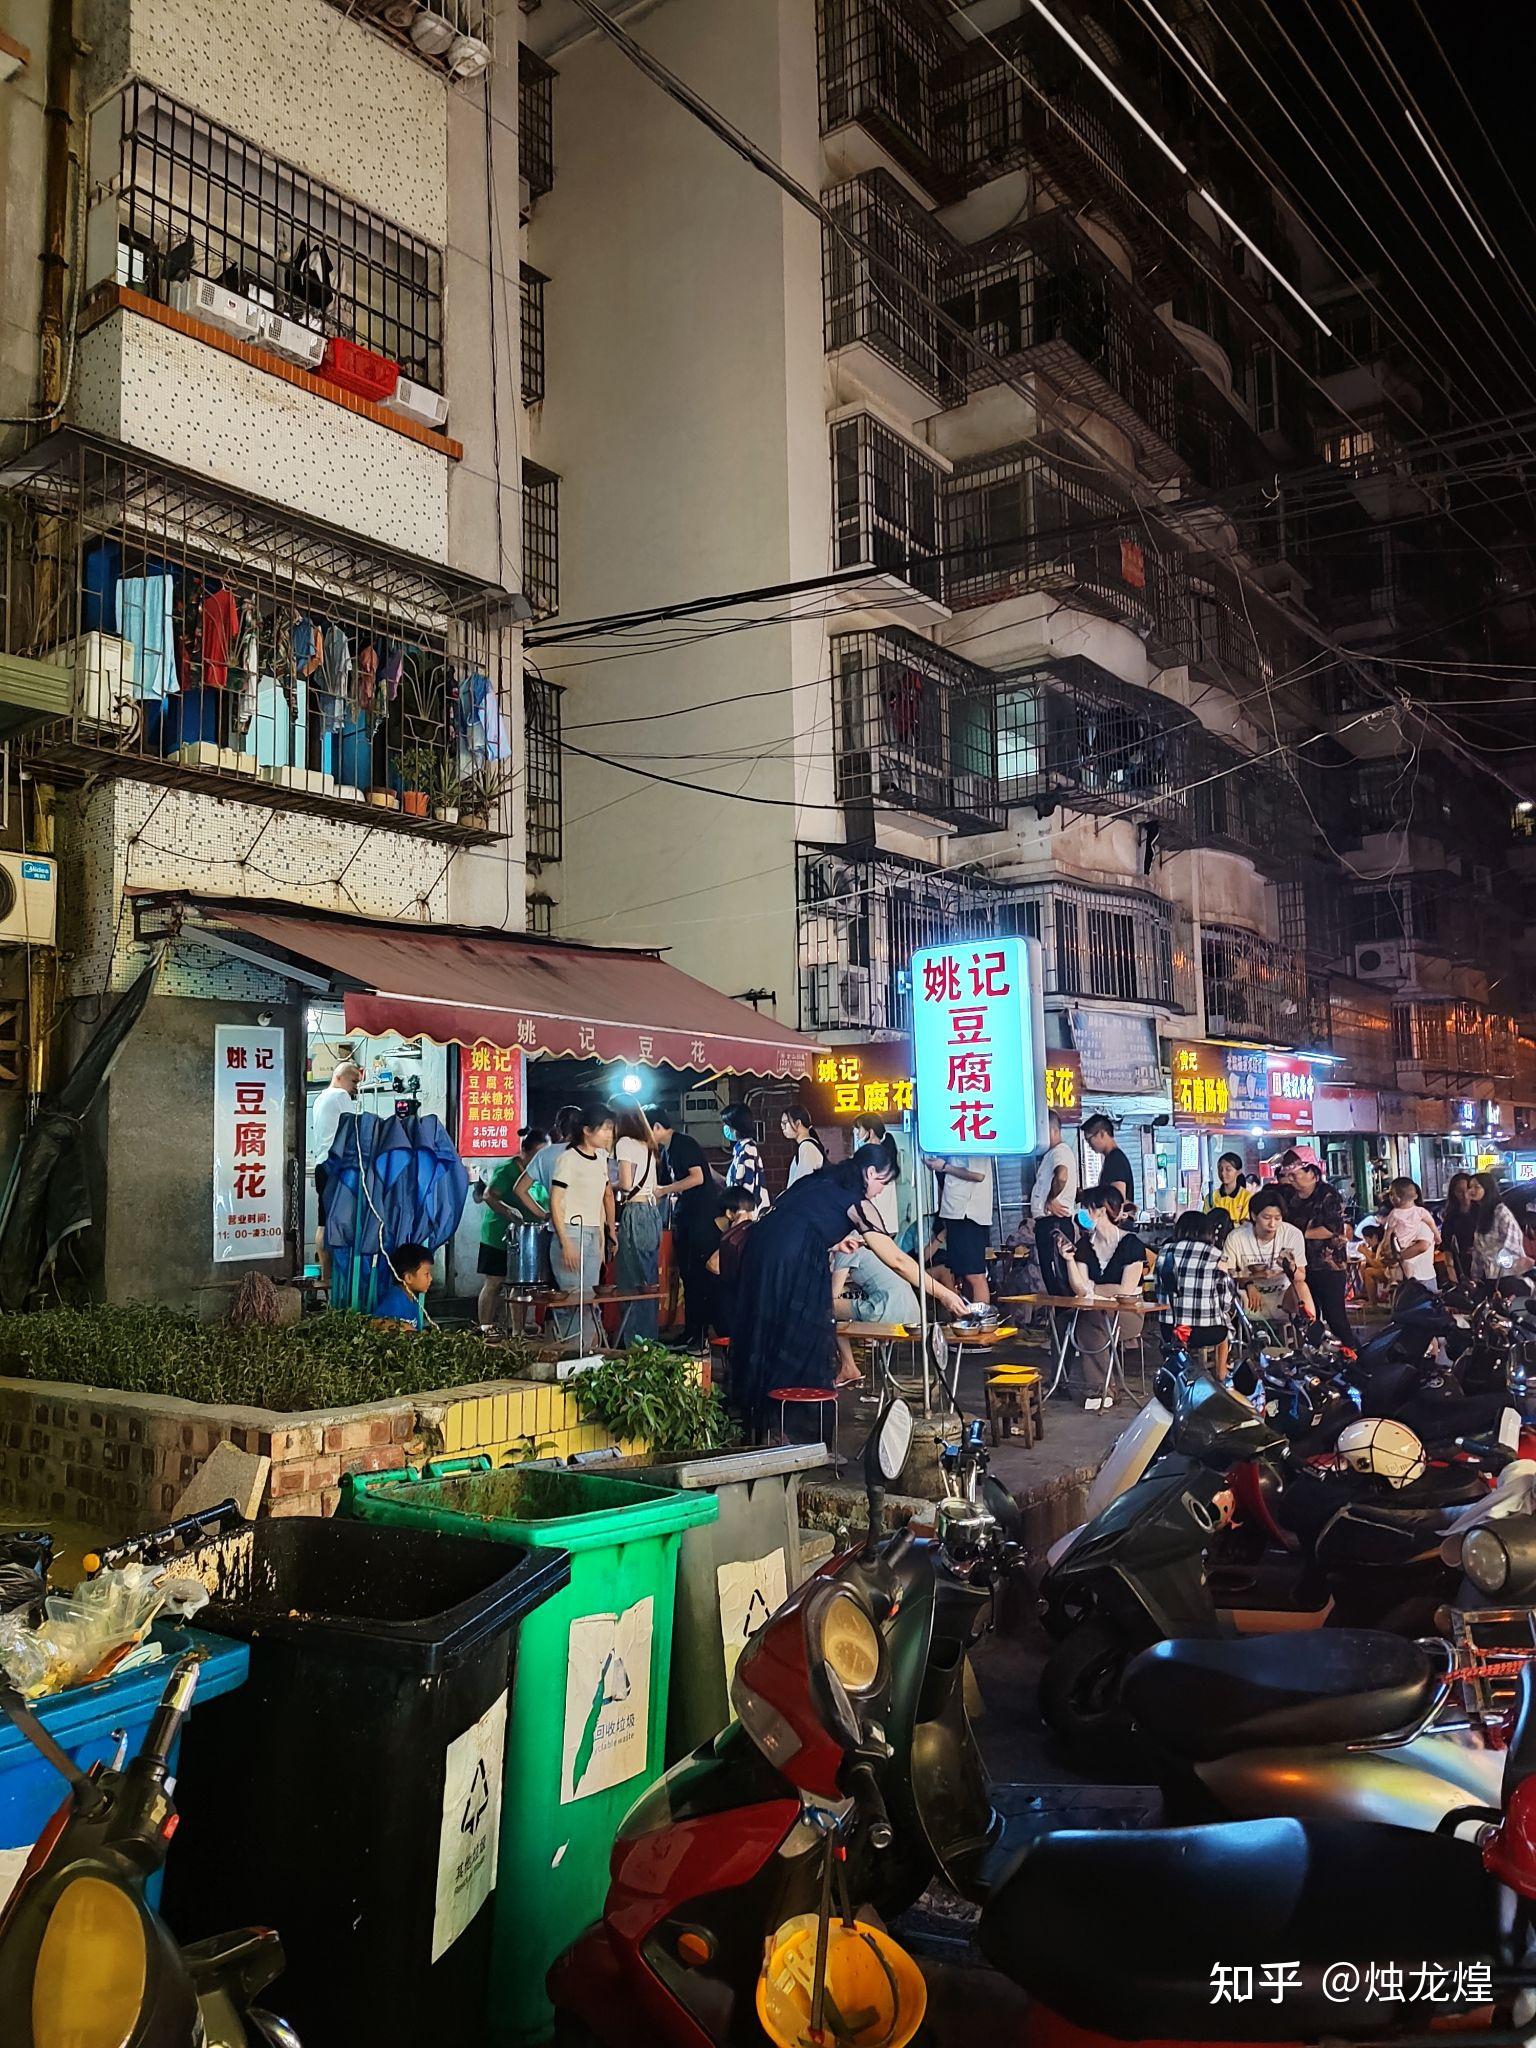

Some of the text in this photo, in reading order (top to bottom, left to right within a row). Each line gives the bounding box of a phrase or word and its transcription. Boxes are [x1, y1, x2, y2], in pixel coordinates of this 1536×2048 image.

[923, 951, 1011, 1003] 姚记
[517, 1019, 706, 1064] 姚记豆花
[226, 1045, 275, 1071] 姚记
[471, 1047, 513, 1073] 姚记
[817, 1057, 860, 1083] 姚记
[468, 1075, 515, 1090] 豆腐花
[946, 1005, 998, 1142] 豆腐花
[468, 1091, 515, 1106] 玉米糖水
[468, 1107, 515, 1121] 黑白凉粉
[233, 1081, 268, 1200] 豆腐花
